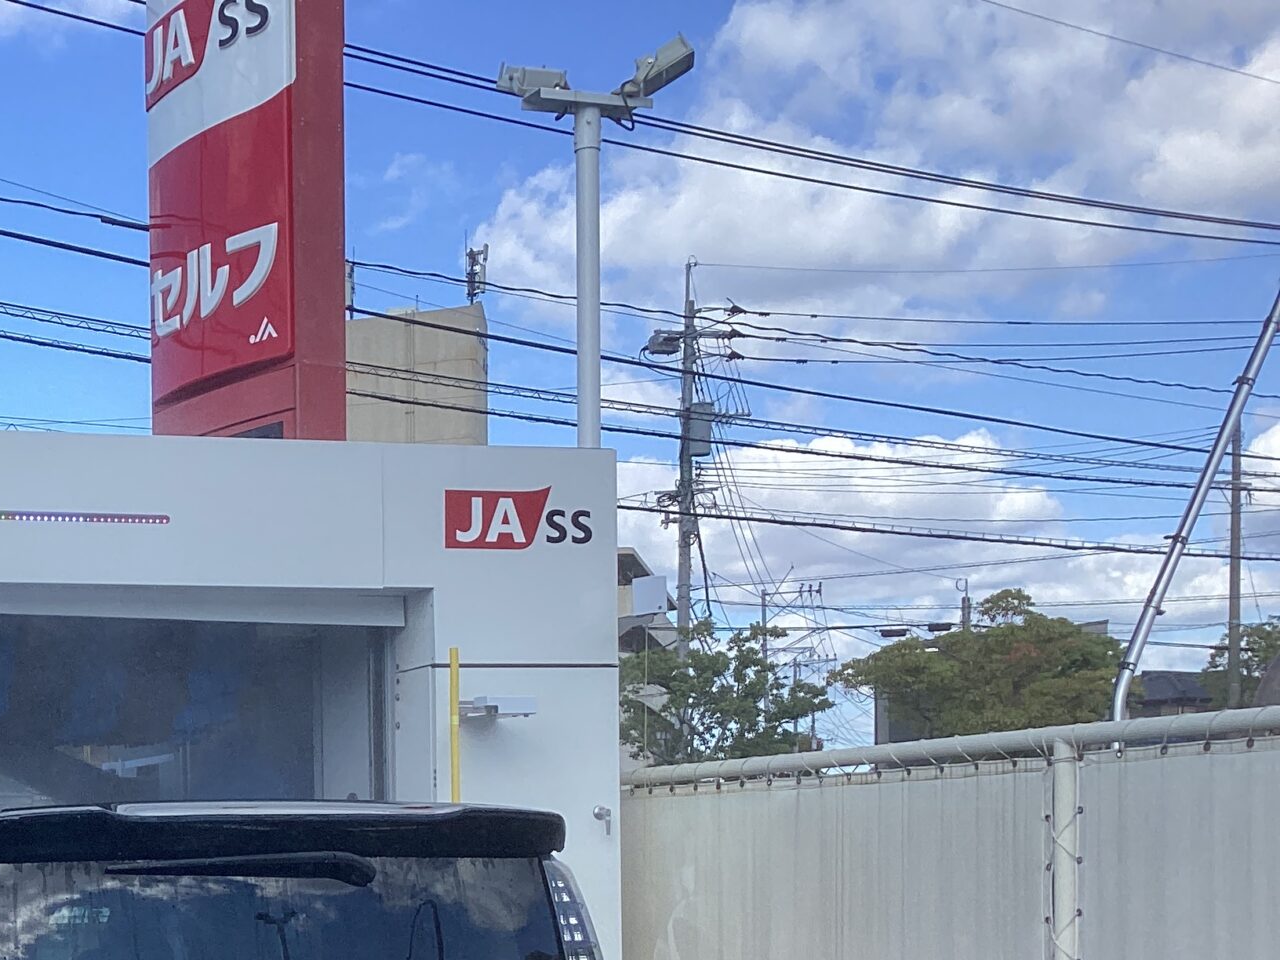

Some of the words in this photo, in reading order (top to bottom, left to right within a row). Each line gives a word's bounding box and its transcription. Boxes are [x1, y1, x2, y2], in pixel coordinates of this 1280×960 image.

[146, 9, 195, 95] JA
[151, 222, 278, 338] セルフ
[455, 496, 527, 543] JA
[545, 509, 593, 544] SS
